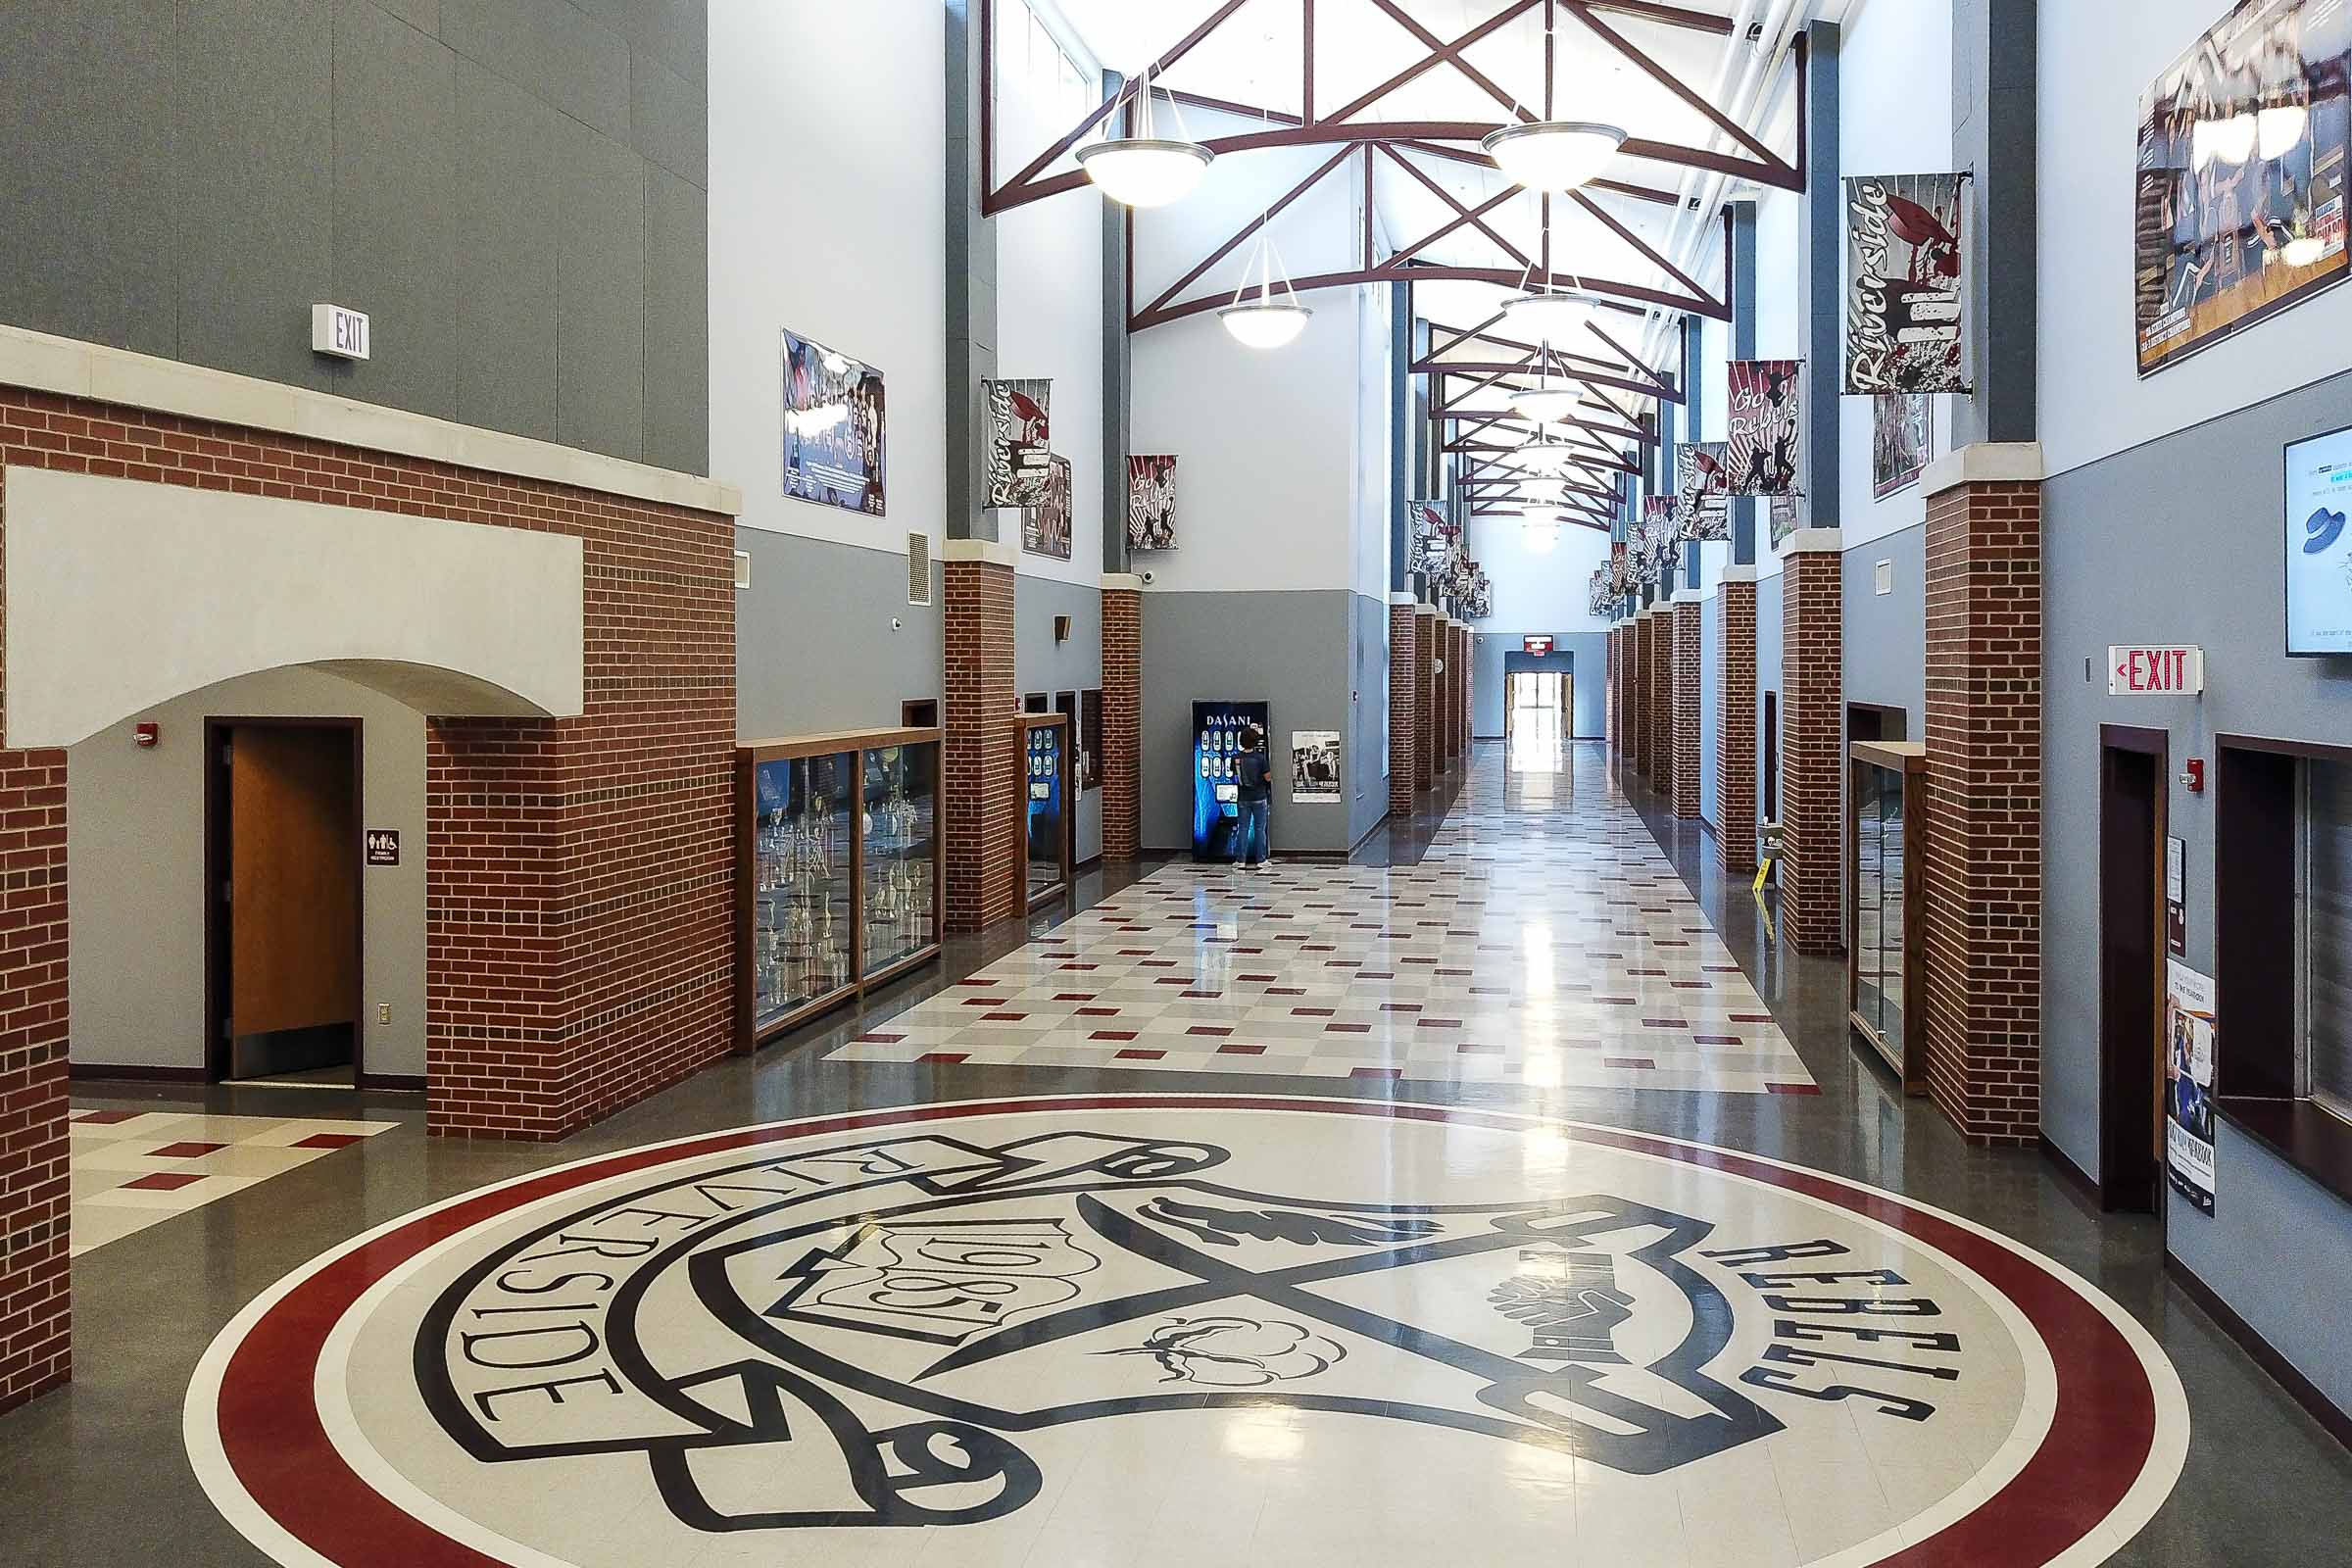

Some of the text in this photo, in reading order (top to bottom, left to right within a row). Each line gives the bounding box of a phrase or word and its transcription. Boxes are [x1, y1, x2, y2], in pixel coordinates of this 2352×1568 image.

[1850, 179, 1889, 390] Riverside
[336, 312, 363, 353] EXIT
[1730, 400, 1799, 437] Rebels
[1734, 387, 1766, 413] Go
[991, 381, 1012, 506] Riverside
[1133, 473, 1154, 492] Go
[1678, 444, 1696, 540] Riverside
[1410, 501, 1425, 572] Riverside
[2129, 650, 2188, 691] EXIT
[1206, 713, 1250, 728] DASANI
[460, 1149, 926, 1422] RIVERSIDE
[867, 1235, 1052, 1317] 1985
[1697, 1238, 1962, 1422] REBELS
